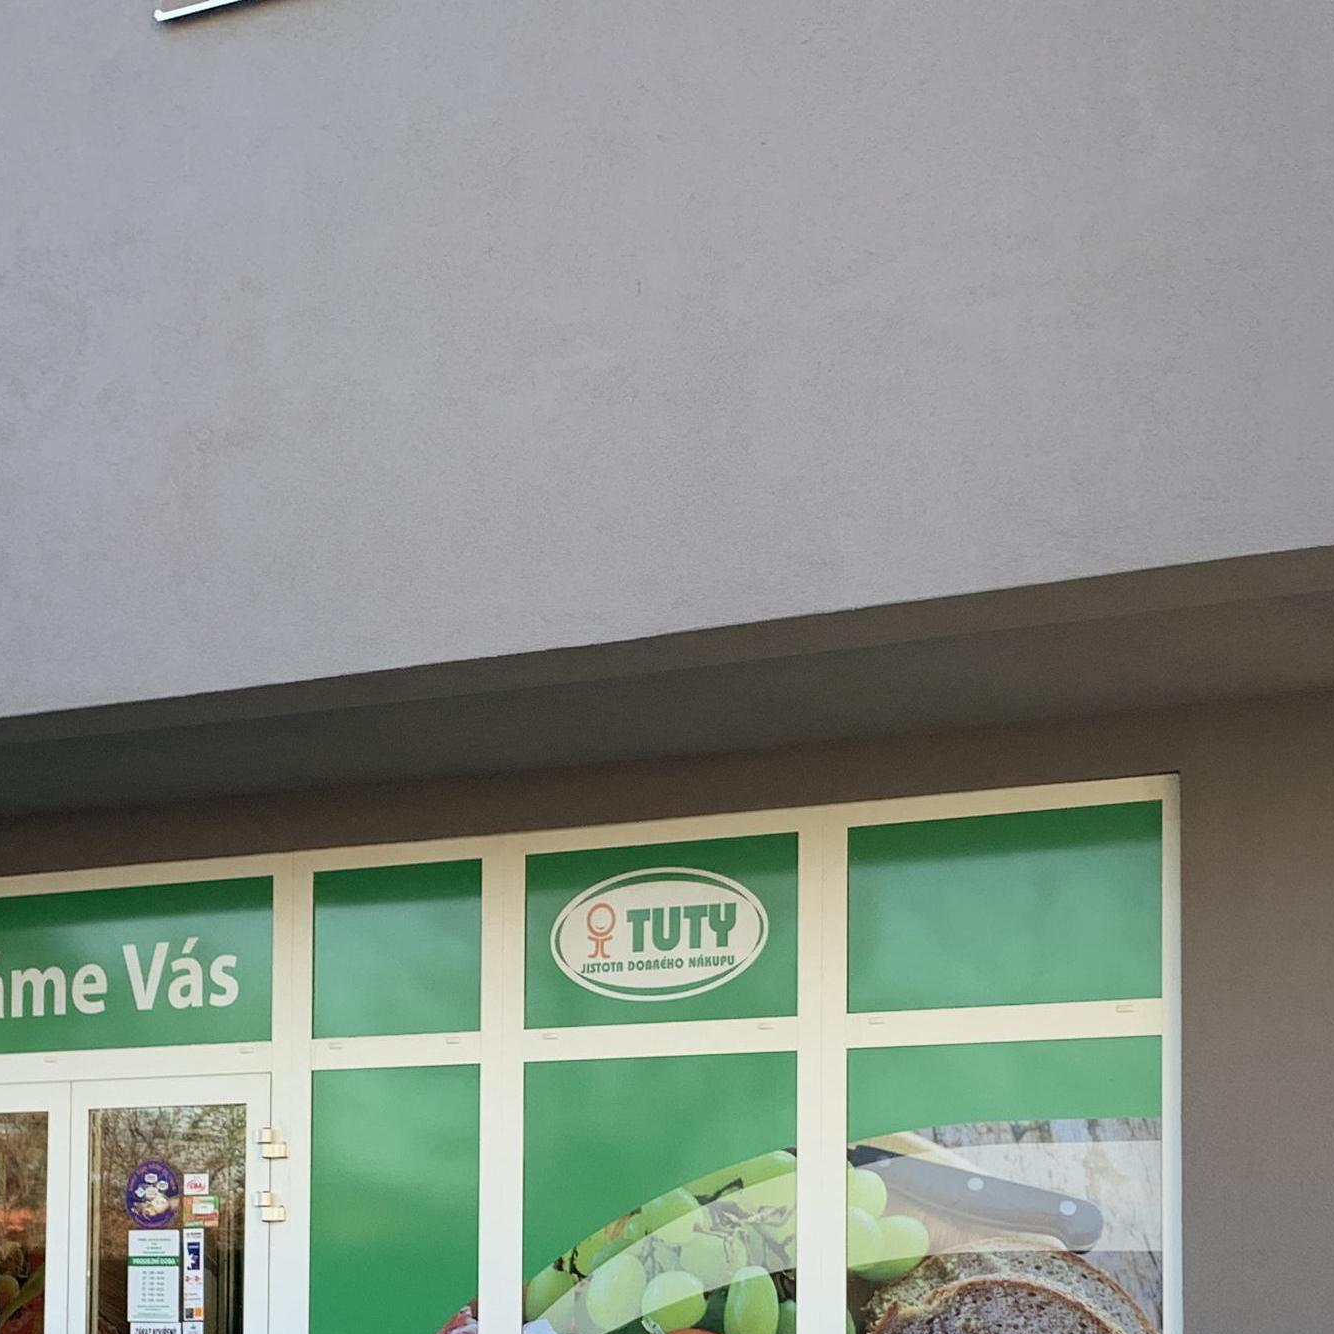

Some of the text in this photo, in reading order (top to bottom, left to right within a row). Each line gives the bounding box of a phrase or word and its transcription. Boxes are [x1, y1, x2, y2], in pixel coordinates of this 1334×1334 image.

[626, 902, 737, 953] TUTY
[122, 936, 240, 1012] Vás
[580, 954, 735, 974] JISTOTA DOBRÉHO NÁKUPU
